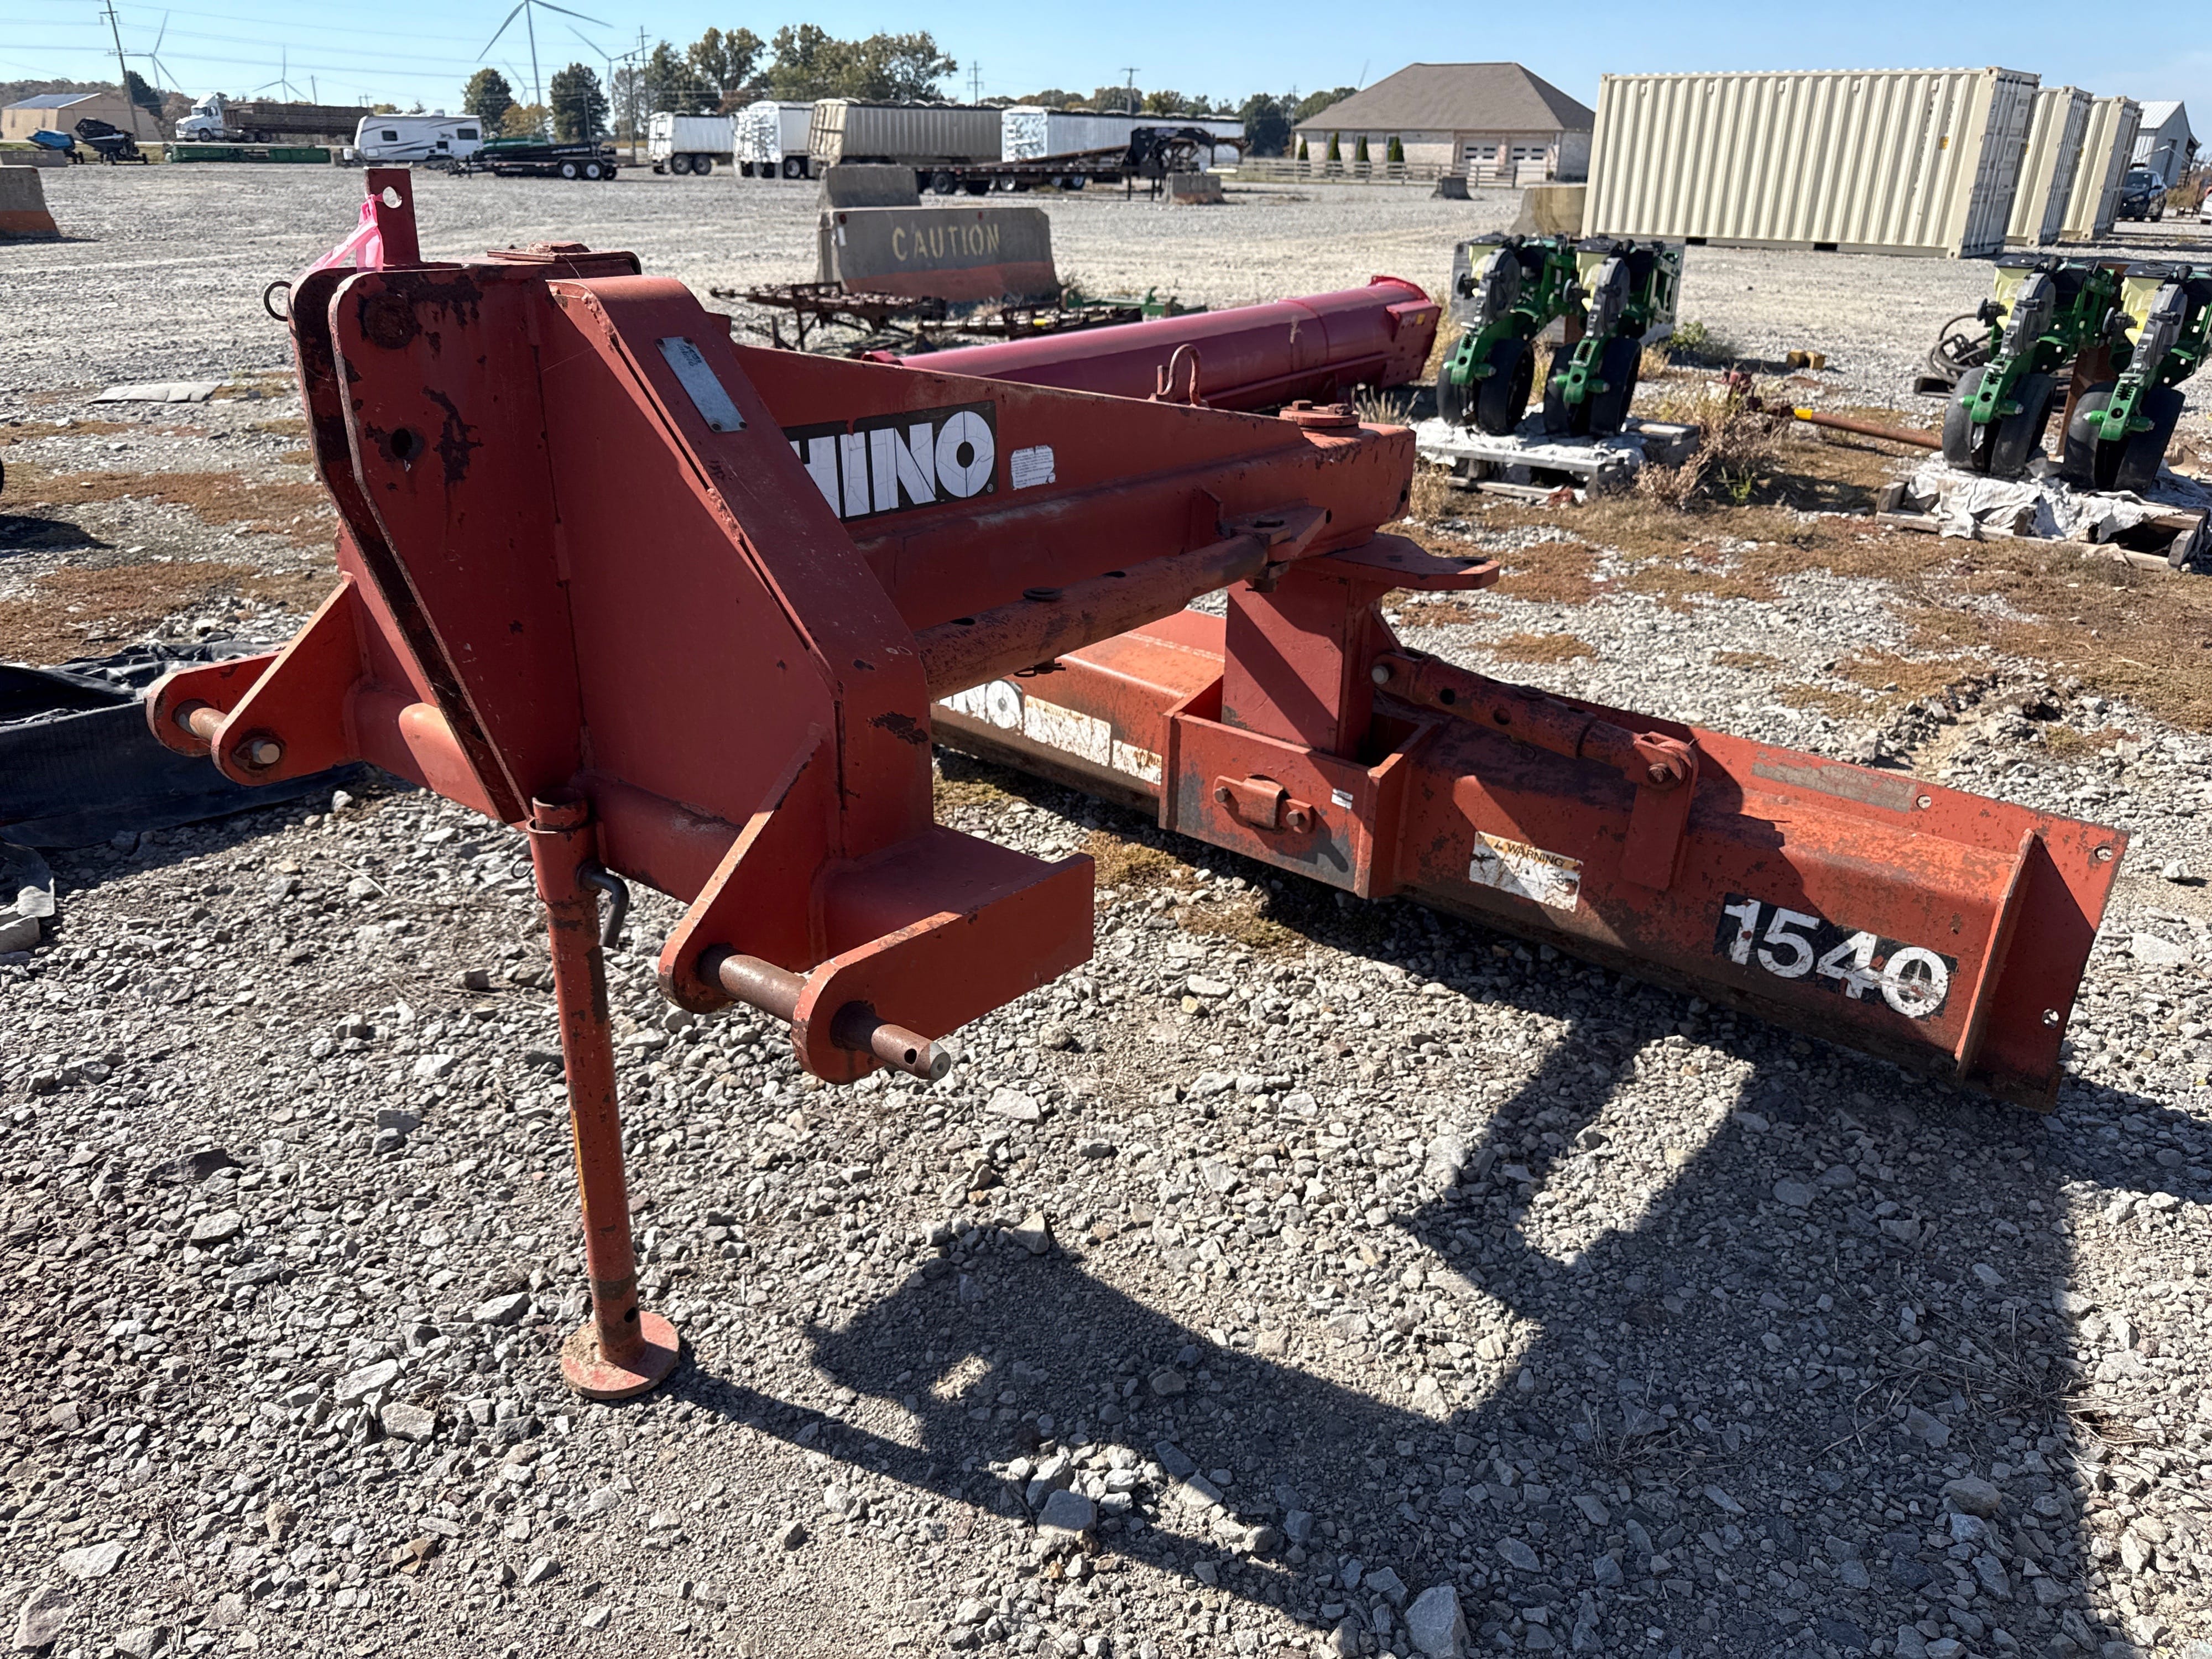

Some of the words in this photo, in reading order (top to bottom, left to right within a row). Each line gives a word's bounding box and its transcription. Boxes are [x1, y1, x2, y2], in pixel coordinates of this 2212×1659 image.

[893, 225, 1000, 261] CAUTION
[1508, 843, 1564, 867] WARNING
[1725, 899, 1948, 1018] 1540
